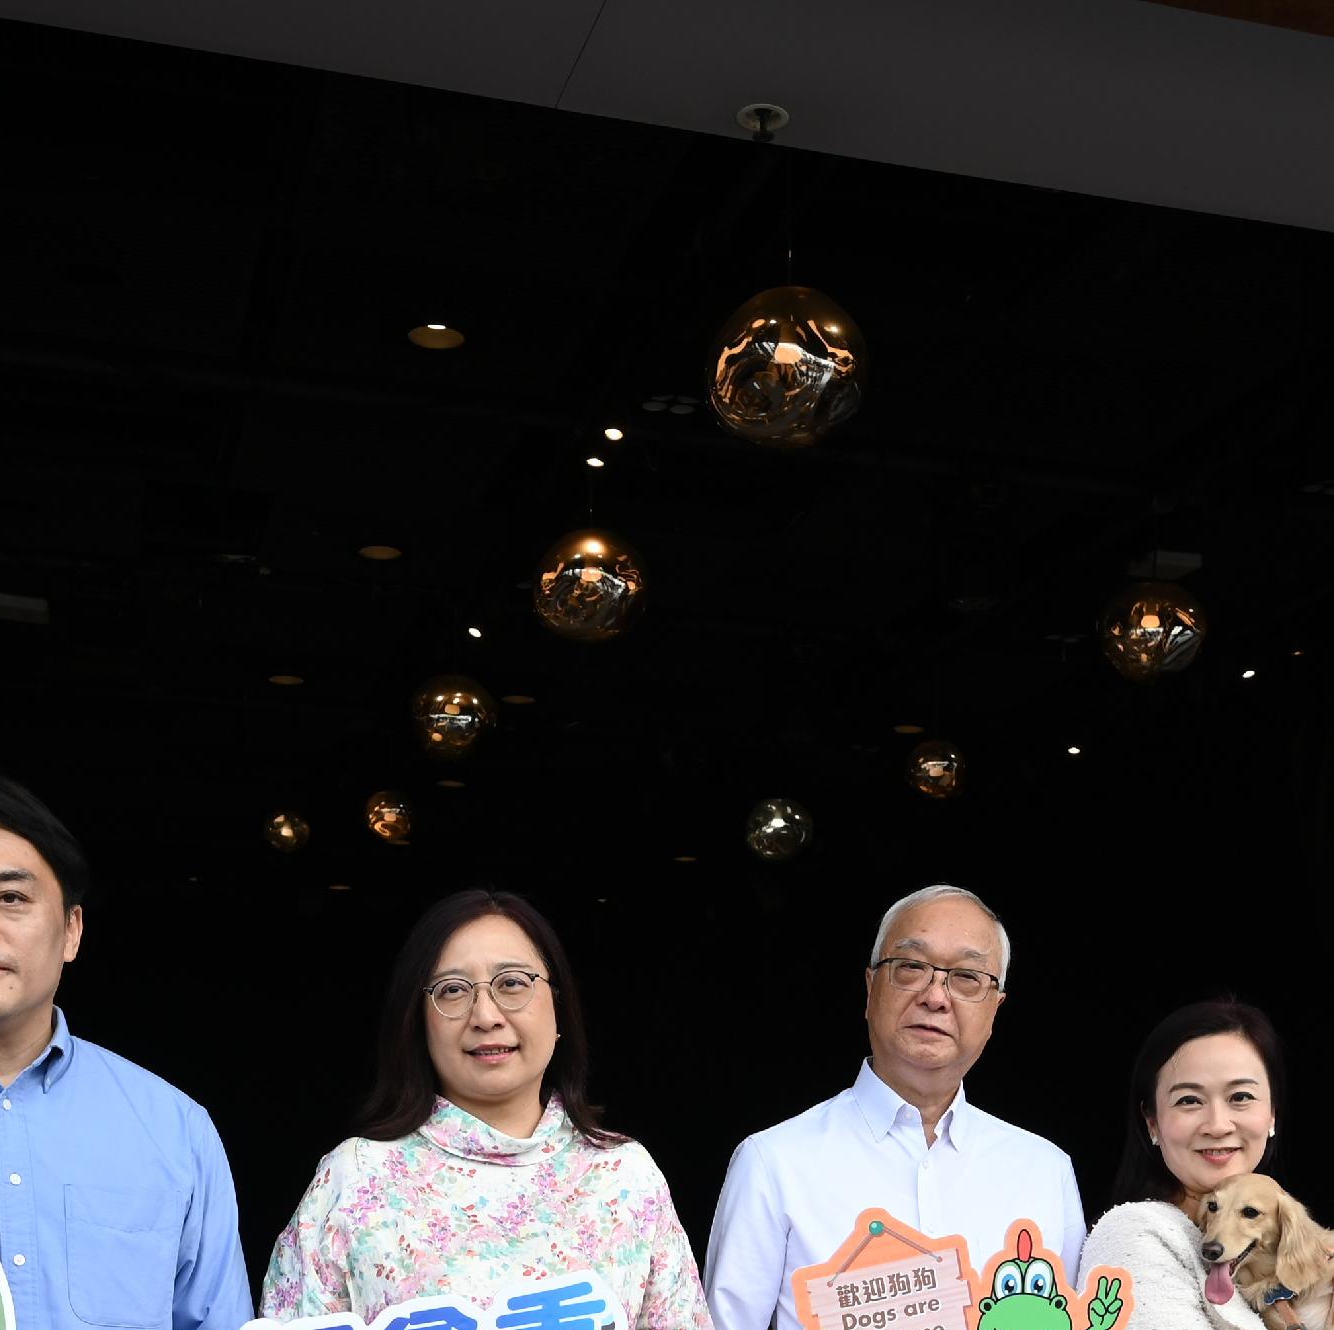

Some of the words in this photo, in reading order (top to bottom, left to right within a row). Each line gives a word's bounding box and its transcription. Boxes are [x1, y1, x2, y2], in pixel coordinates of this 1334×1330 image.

[835, 1267, 937, 1308] 歡迎狗狗
[841, 1307, 897, 1330] Dogs
[903, 1298, 940, 1317] are
